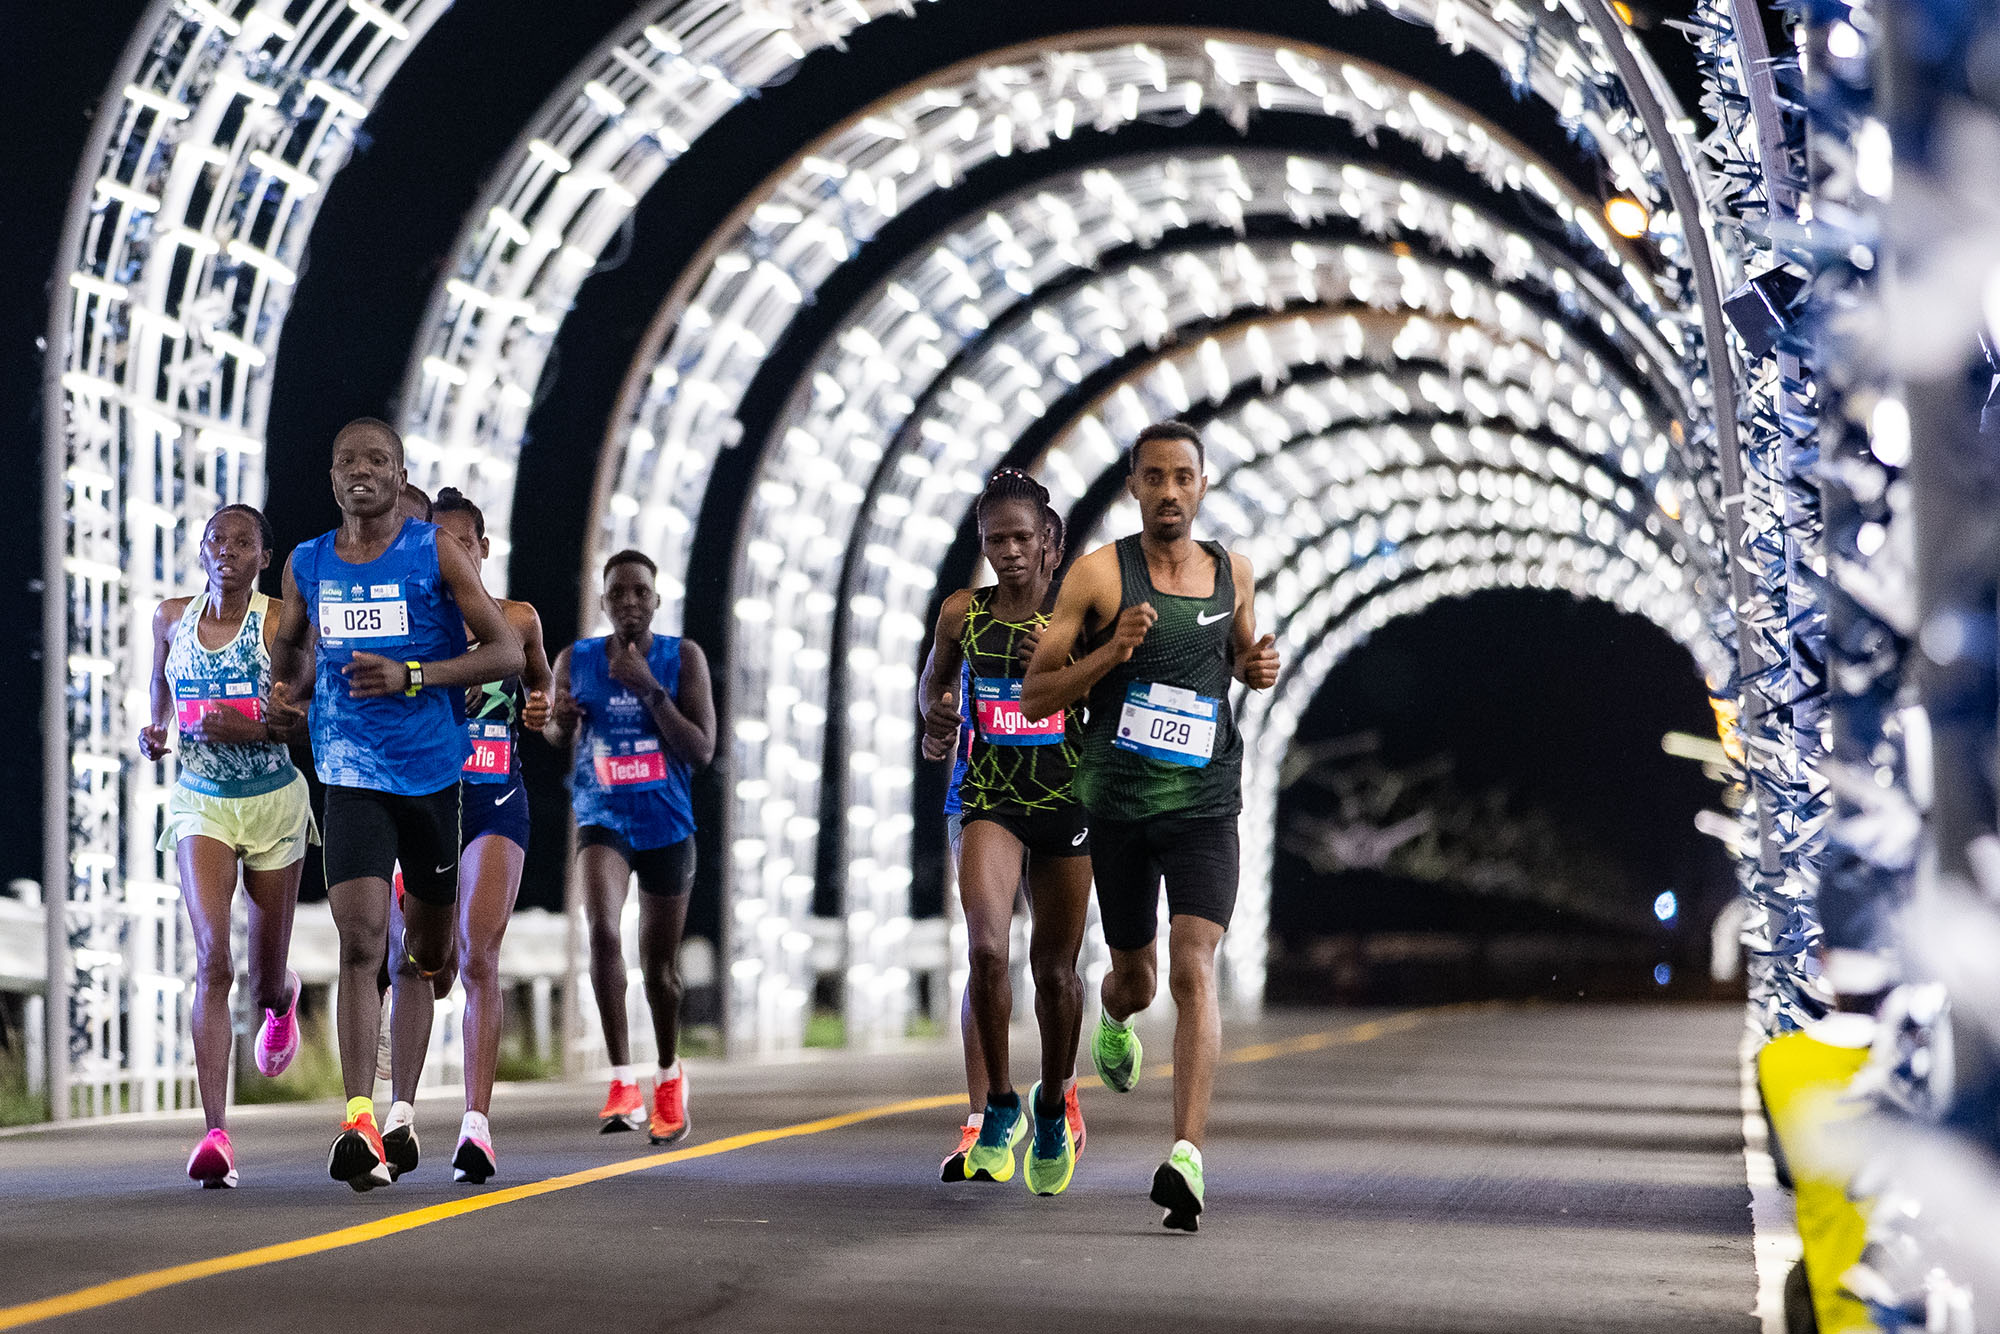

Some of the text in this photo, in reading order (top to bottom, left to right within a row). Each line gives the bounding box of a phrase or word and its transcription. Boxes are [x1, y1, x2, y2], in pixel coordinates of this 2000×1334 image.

[344, 609, 382, 631] 025
[1150, 718, 1191, 746] 029
[609, 759, 651, 780] Tecla
[201, 780, 220, 793] RUN
